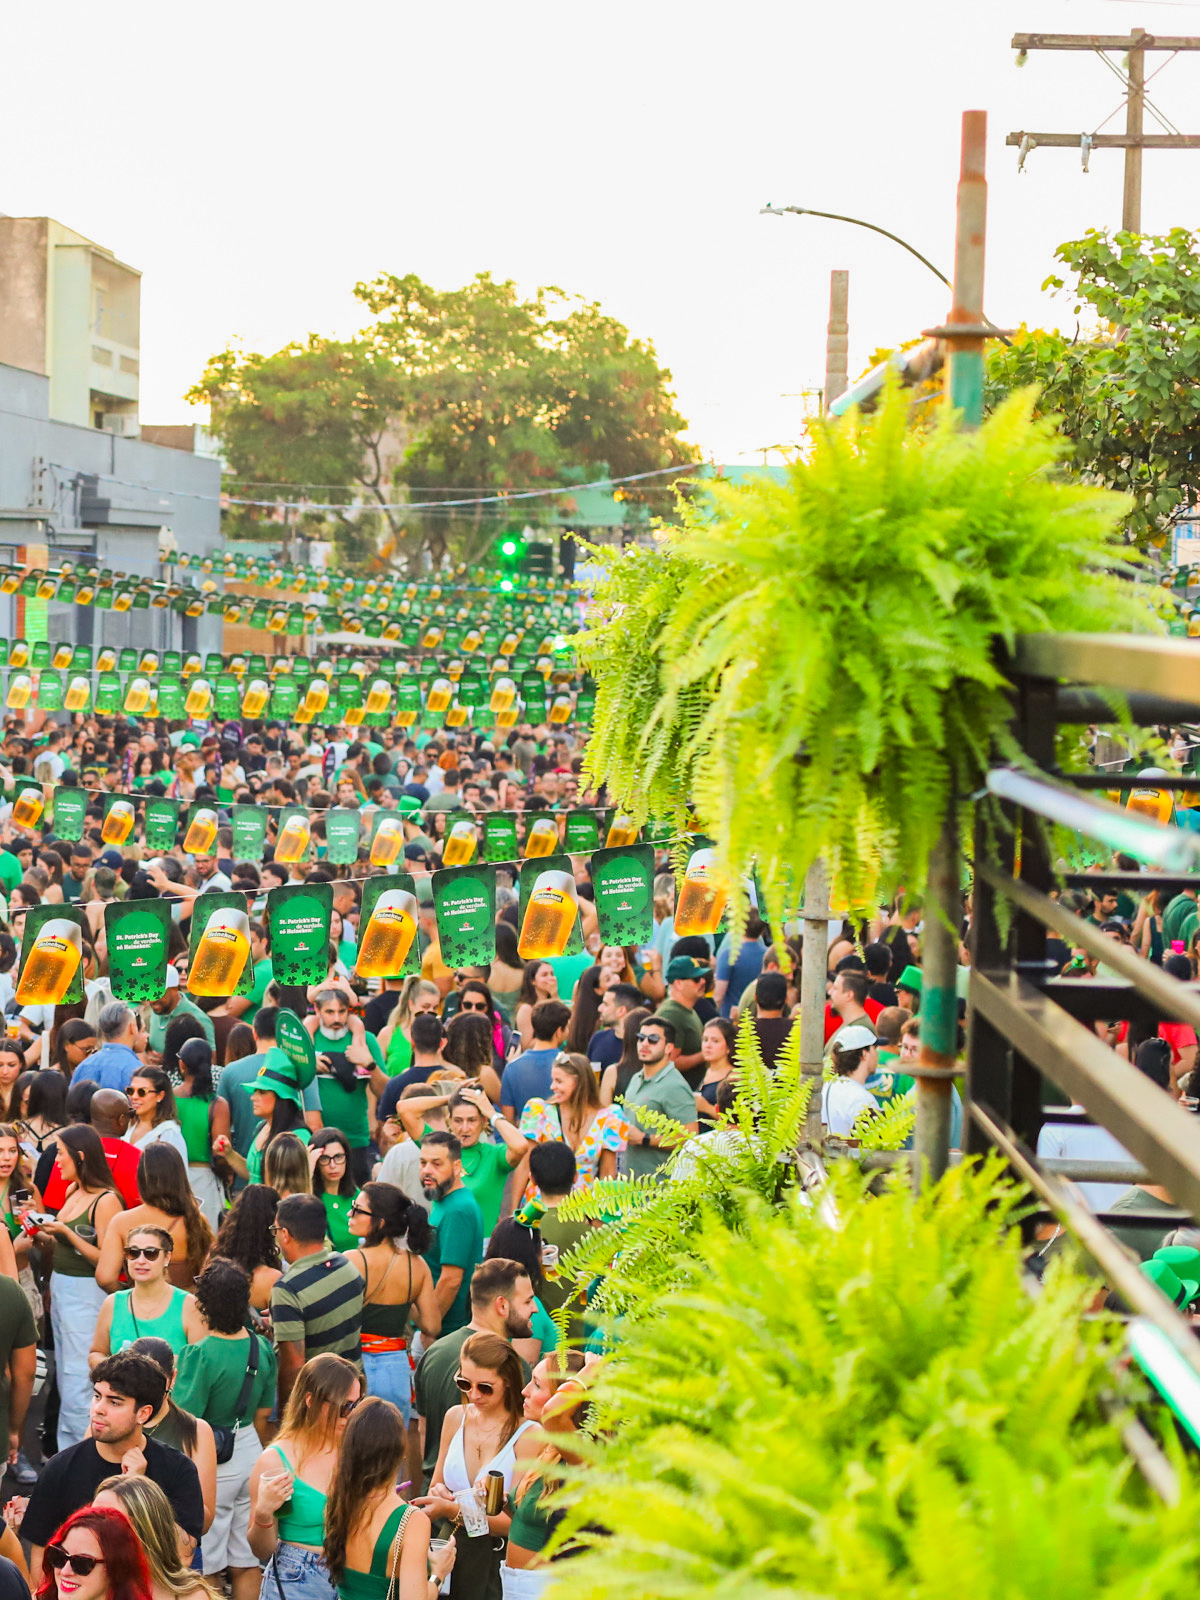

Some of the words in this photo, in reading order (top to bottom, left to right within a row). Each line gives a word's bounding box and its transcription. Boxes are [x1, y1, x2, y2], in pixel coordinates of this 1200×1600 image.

[535, 892, 562, 904] Heineken
[376, 912, 402, 923] Heineken
[208, 931, 235, 942] Heineken
[38, 941, 66, 951] Heineken
